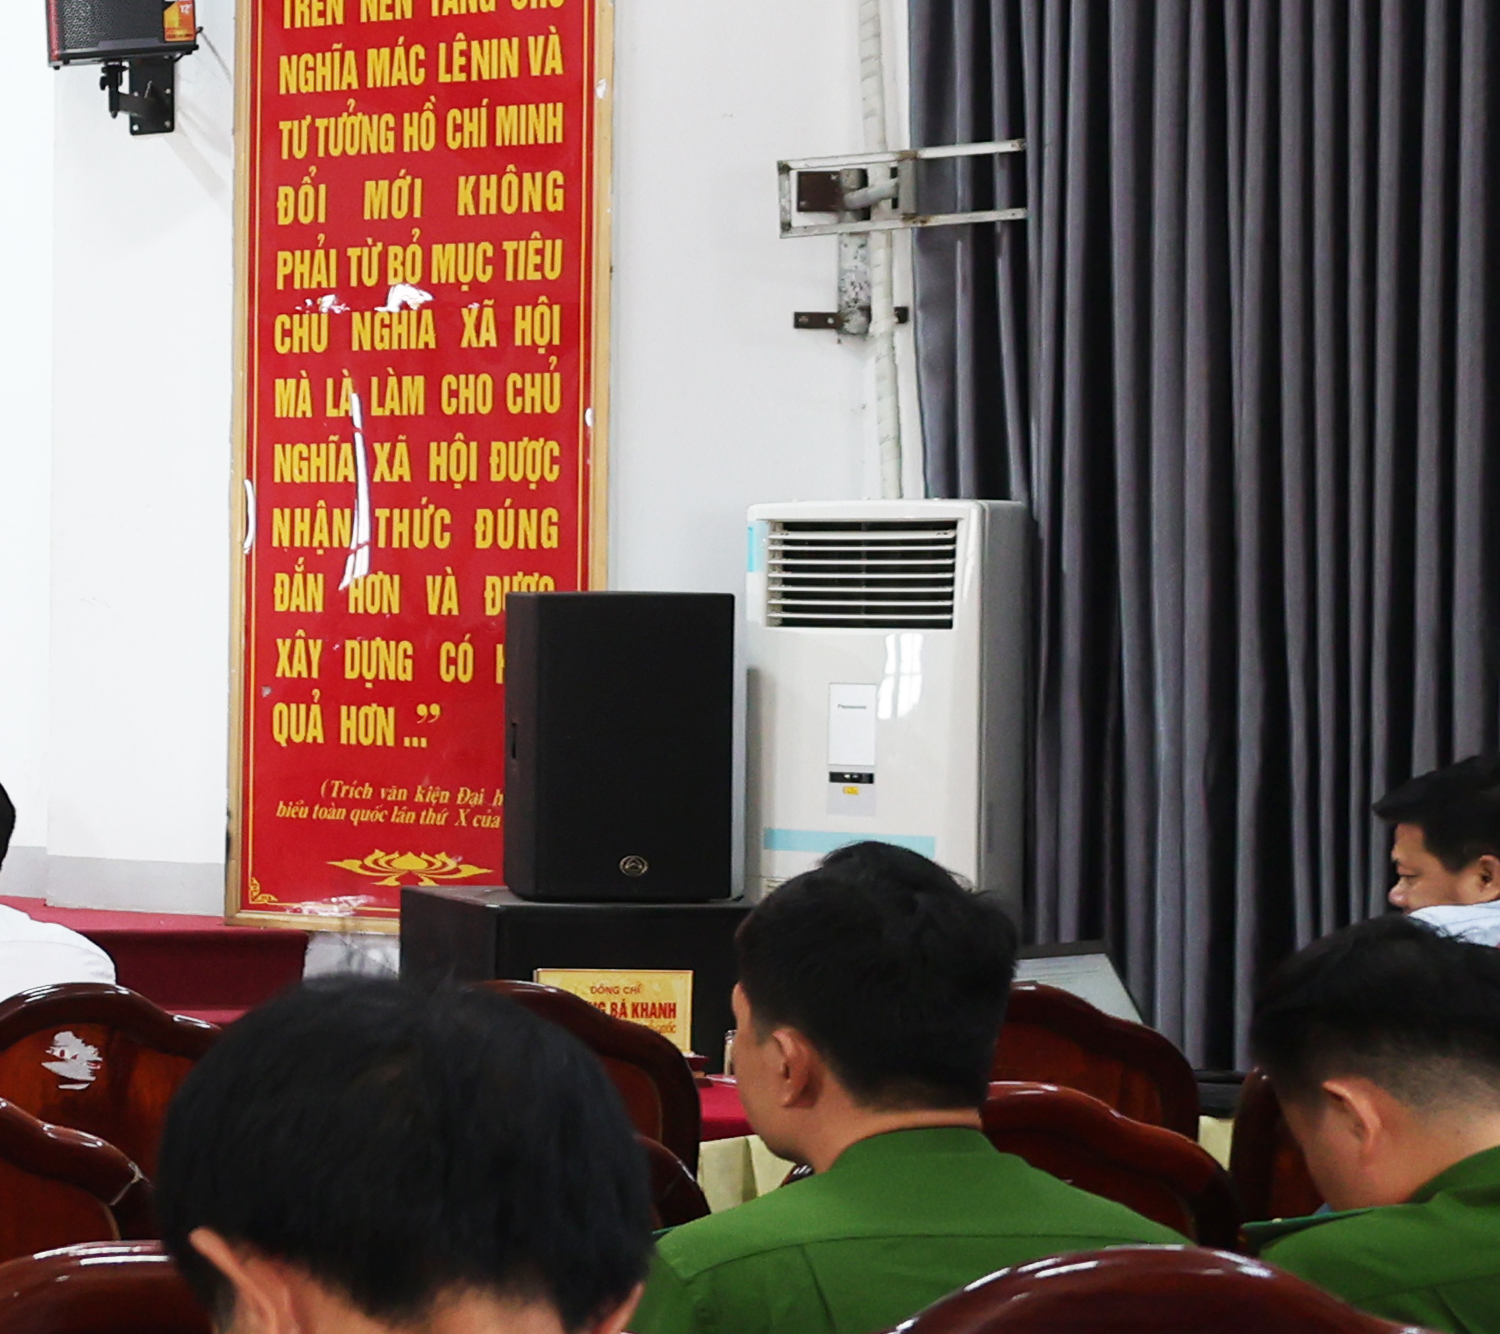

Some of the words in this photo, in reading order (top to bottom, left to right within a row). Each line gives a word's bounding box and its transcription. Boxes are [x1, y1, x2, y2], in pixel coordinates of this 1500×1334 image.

[279, 115, 311, 159] TƯ
[315, 99, 395, 157] TƯỞNG
[404, 96, 435, 152] HỒ
[447, 99, 488, 149] CHÍ
[496, 103, 563, 146] MINH
[277, 234, 336, 289] PHẢI
[347, 239, 382, 286] TỪ
[388, 228, 422, 285] BỎ
[432, 242, 493, 291] MỤC
[503, 232, 562, 281] TIÊU
[371, 368, 424, 416] LÀM
[442, 374, 492, 415] CHO
[507, 356, 560, 414] CHỦ
[375, 498, 451, 549] THỨC
[475, 499, 558, 549] ĐÚNG
[276, 630, 322, 678] XÂY
[345, 638, 413, 688] DỰNG
[440, 635, 473, 682] CÓ
[277, 799, 308, 819] biểu
[312, 803, 346, 820] toàn
[350, 804, 388, 826] quốc
[419, 807, 449, 826] thứ
[454, 808, 470, 827] X
[473, 809, 500, 828] của
[381, 785, 408, 801] văn
[414, 785, 451, 806] kiện
[456, 787, 484, 807] Đại
[632, 1002, 676, 1018] KHANH
